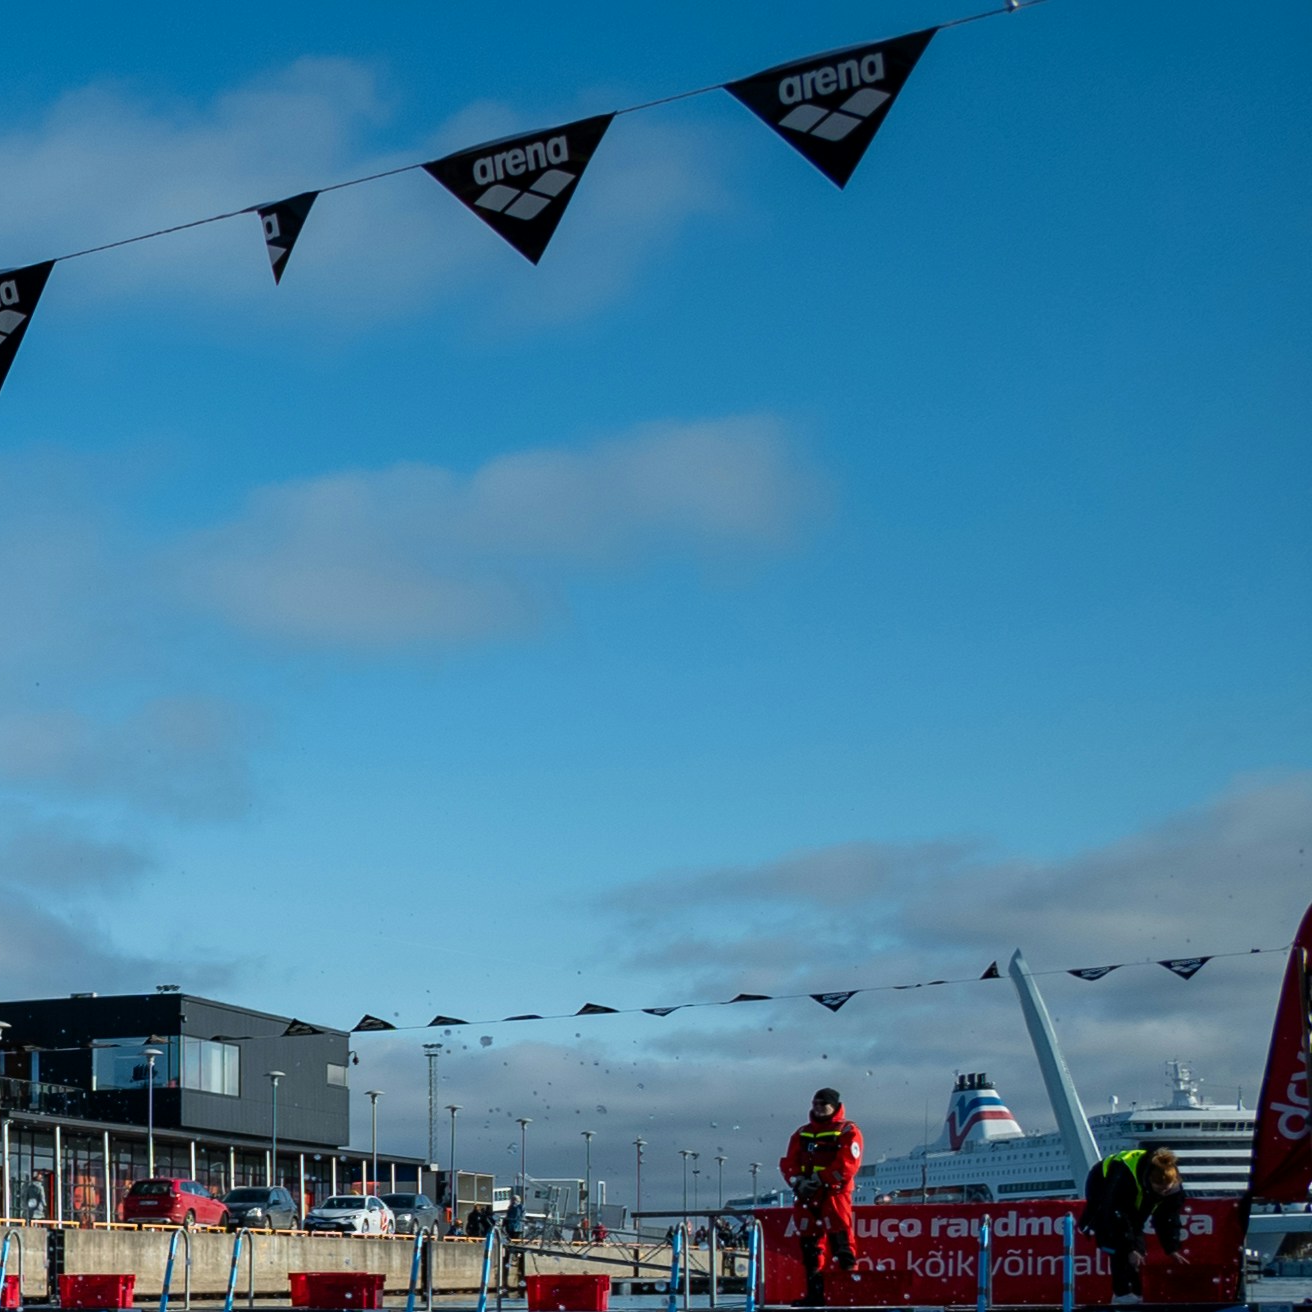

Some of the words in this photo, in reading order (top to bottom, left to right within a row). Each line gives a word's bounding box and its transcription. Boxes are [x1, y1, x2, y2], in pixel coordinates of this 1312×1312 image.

[778, 52, 885, 105] arena
[473, 134, 569, 186] arena
[907, 1250, 974, 1278] kõik
[991, 1248, 1113, 1276] võimali
